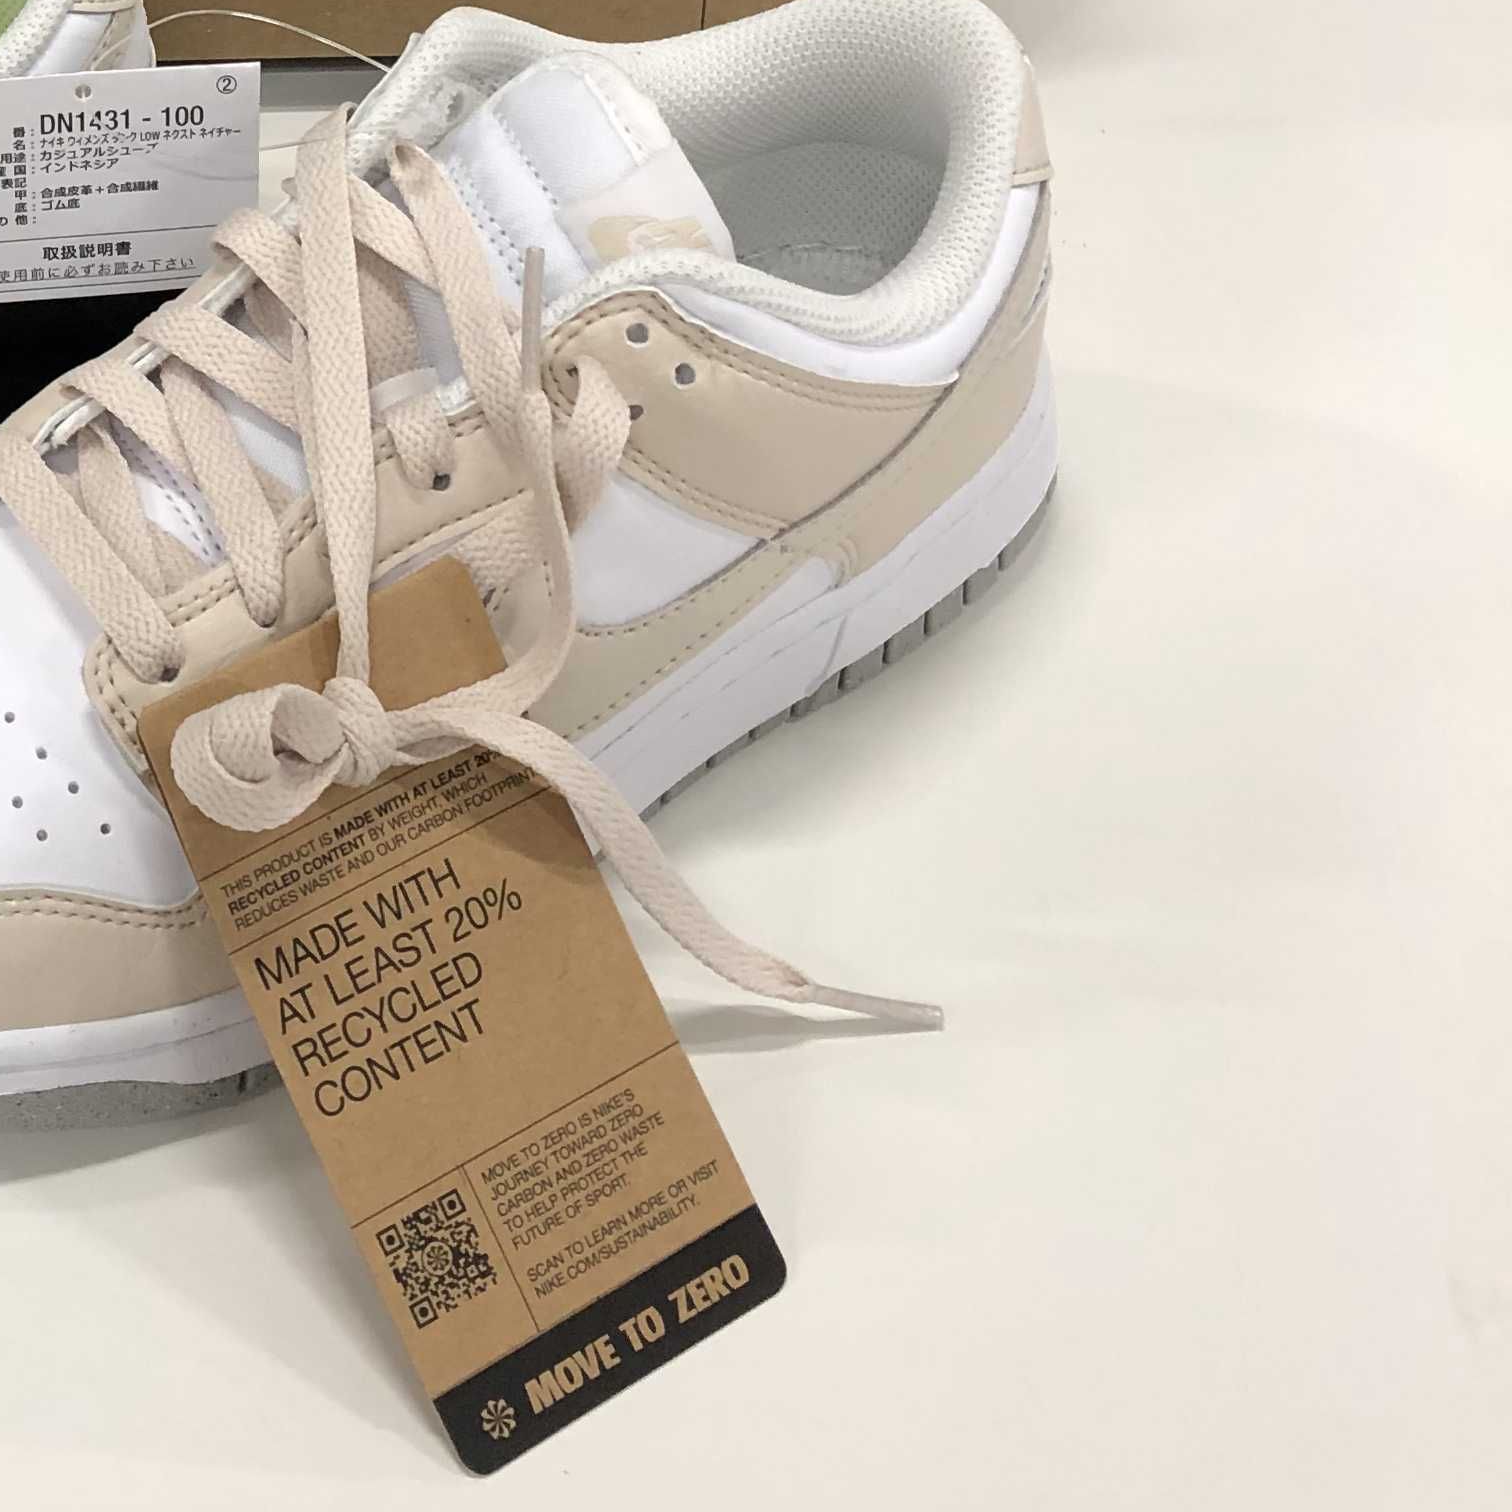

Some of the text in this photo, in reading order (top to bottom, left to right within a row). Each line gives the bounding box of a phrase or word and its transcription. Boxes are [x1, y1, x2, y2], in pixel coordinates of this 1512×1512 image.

[40, 108, 131, 135] DN1431
[161, 105, 204, 127] 100
[43, 241, 132, 261] 取扱説明書
[221, 874, 251, 898] THIS
[253, 840, 318, 882] PRODUCT
[318, 832, 332, 847] IS
[333, 810, 375, 839] MADE
[375, 792, 410, 817] WITH
[410, 782, 430, 799] AT
[430, 759, 473, 789] LEAST
[228, 868, 301, 914] RECYCLED
[301, 834, 366, 875] CONTENT
[368, 823, 387, 840] BY
[442, 771, 486, 802] WHICH
[234, 889, 298, 931] REDUCES
[299, 865, 345, 896] WASTE
[345, 850, 374, 872] AND
[376, 833, 406, 856] OUR
[406, 804, 463, 840] CARBON
[254, 858, 461, 990] MADE WITH
[279, 878, 522, 1035] AT LEAST 20%
[292, 952, 482, 1076] RECYCLED
[314, 998, 483, 1116] CONTENT
[481, 1154, 520, 1183] MOVE
[521, 1143, 539, 1160] TO
[540, 1122, 577, 1149] ZERO
[578, 1113, 591, 1127] IS
[489, 1104, 643, 1200] JOURNEY TOWARD ZERO
[496, 1112, 664, 1216] CARBON AND ZERO WASTE
[504, 1143, 646, 1233] TO HELP PROTECT THE
[511, 1213, 563, 1250] FUTURE
[564, 1201, 583, 1219] OF
[527, 1161, 719, 1281] SCAN TO LEARN MORE OR VISIT
[523, 1254, 750, 1414] MOVE TO ZERO
